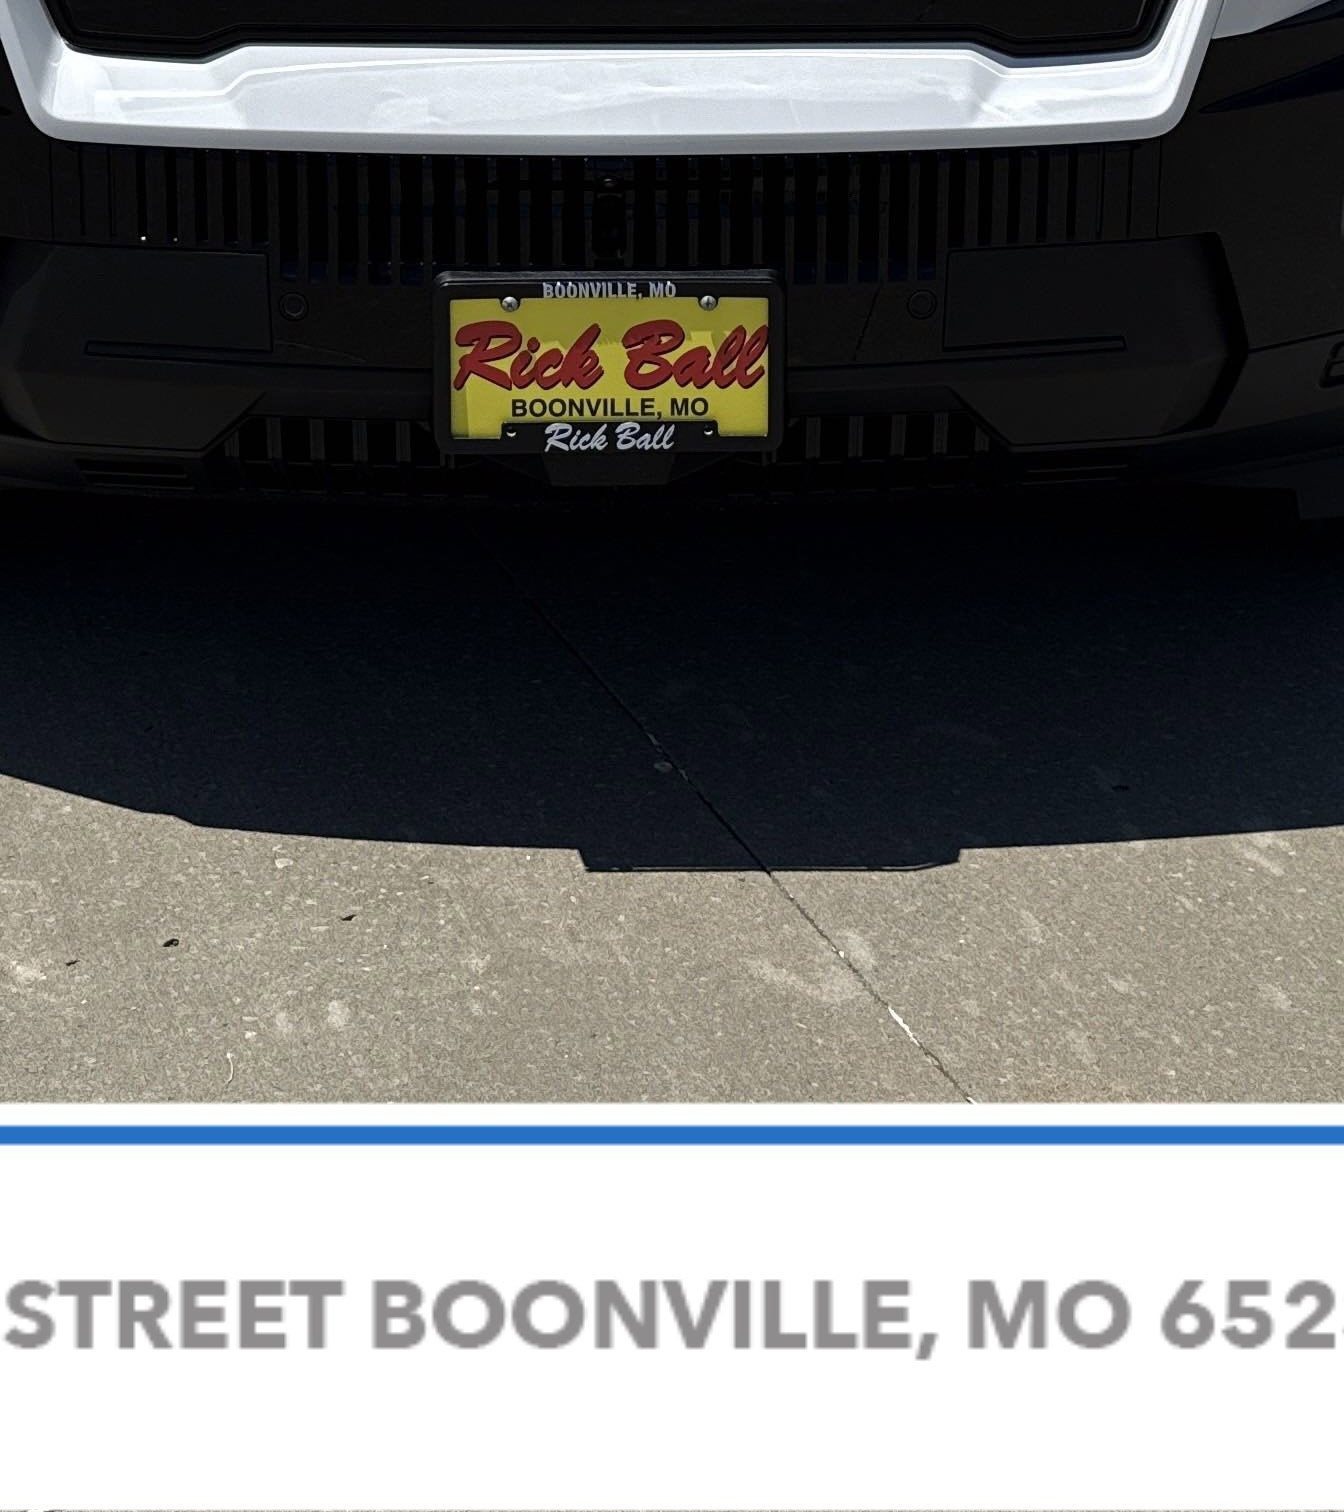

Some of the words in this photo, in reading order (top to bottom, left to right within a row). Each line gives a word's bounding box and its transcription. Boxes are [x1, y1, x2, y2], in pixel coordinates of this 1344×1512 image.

[542, 282, 643, 300] BOONVILLE,
[649, 281, 676, 298] MO
[453, 320, 605, 391] Rick
[621, 319, 769, 390] Ball
[511, 398, 662, 420] BOONVILLE,
[670, 397, 709, 416] MO
[544, 422, 608, 453] Rick
[615, 422, 675, 451] Ball
